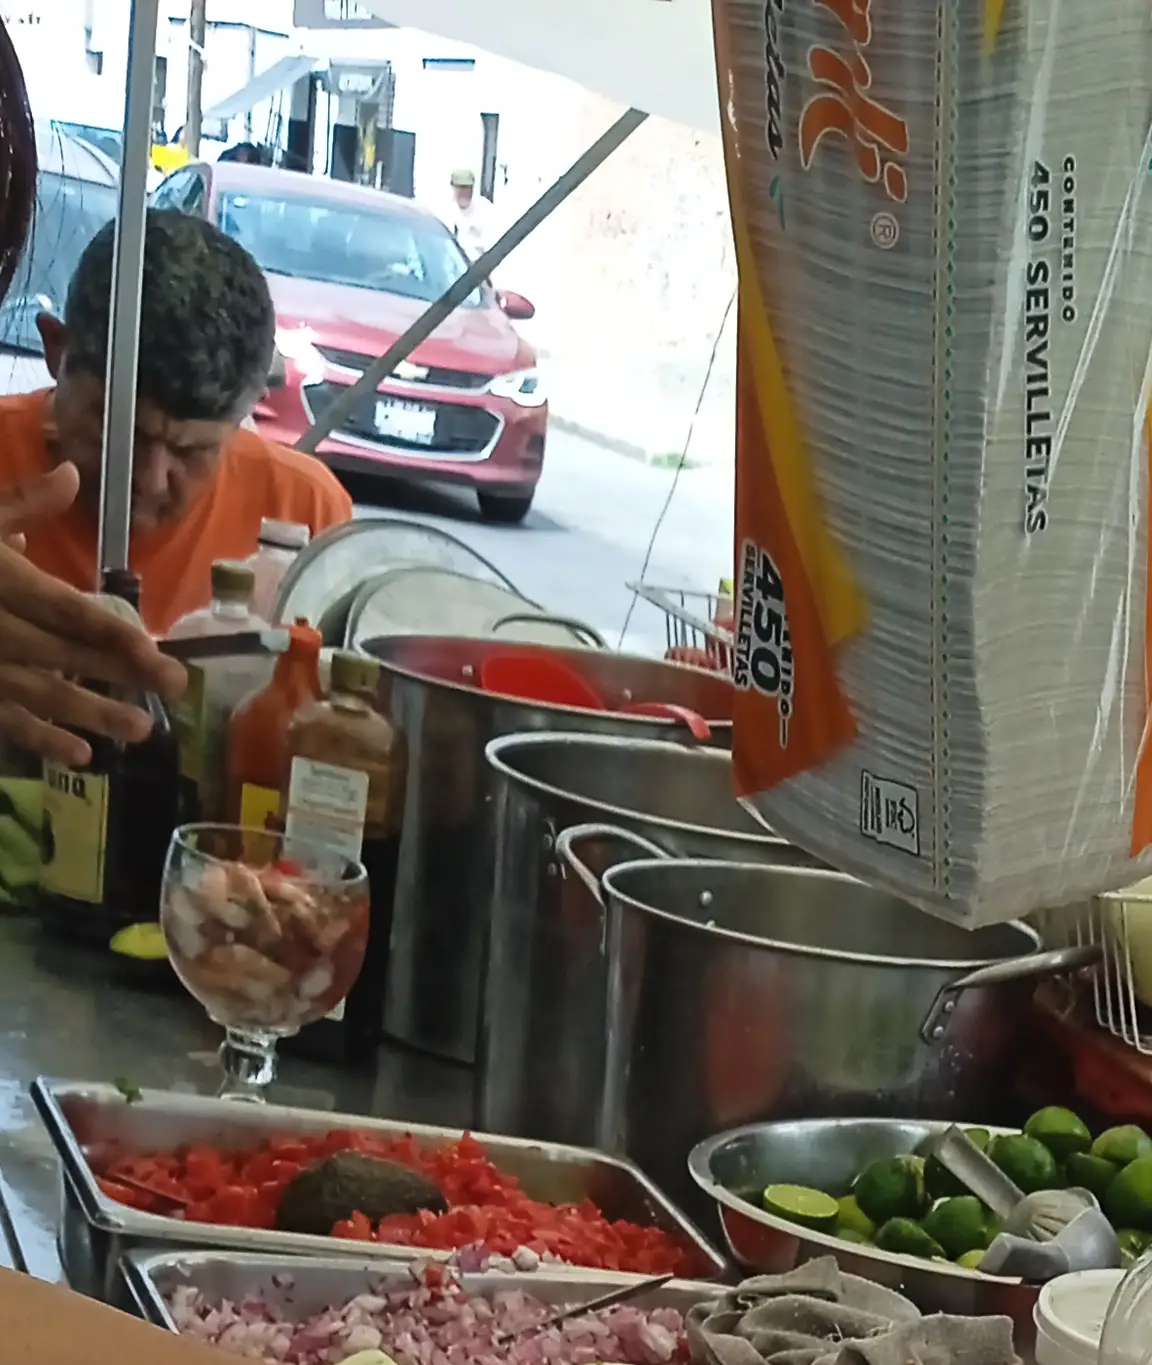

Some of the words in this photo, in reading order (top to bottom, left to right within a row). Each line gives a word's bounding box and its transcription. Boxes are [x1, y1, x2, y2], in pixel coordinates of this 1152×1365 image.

[1026, 159, 1051, 243] 450
[1062, 156, 1075, 323] CONTENIDO
[1024, 259, 1052, 534] SERVILLETAS
[734, 543, 756, 688] SERVILLETAS
[751, 552, 785, 693] 450
